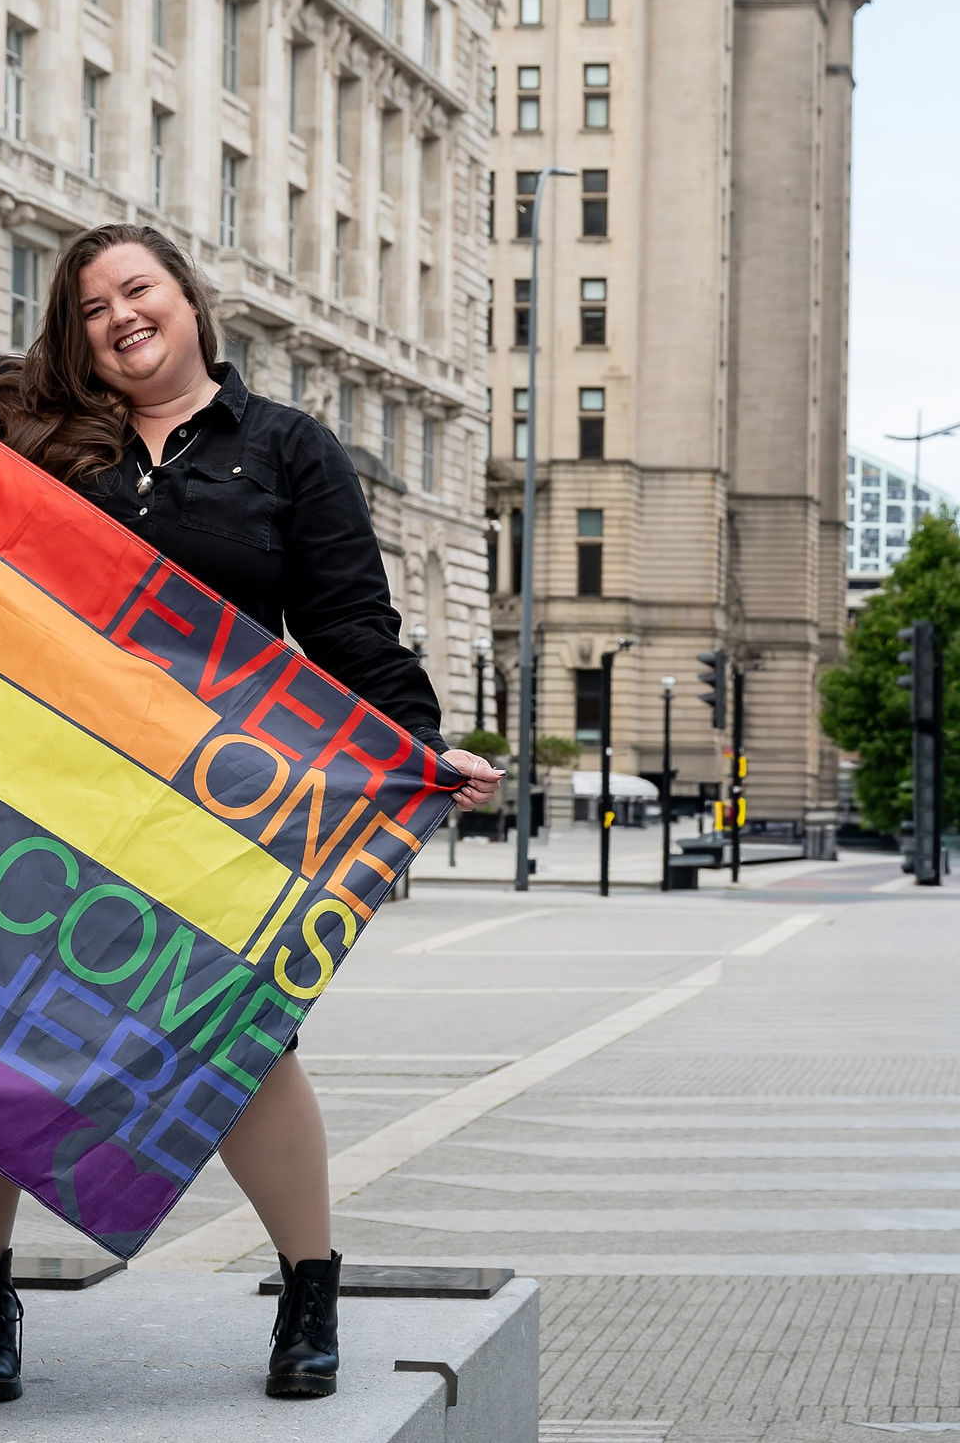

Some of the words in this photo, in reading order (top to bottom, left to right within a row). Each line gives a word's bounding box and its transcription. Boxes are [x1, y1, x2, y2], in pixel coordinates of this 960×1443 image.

[110, 556, 467, 826] EVERY
[193, 733, 423, 923] ONE
[244, 877, 357, 1000] IS
